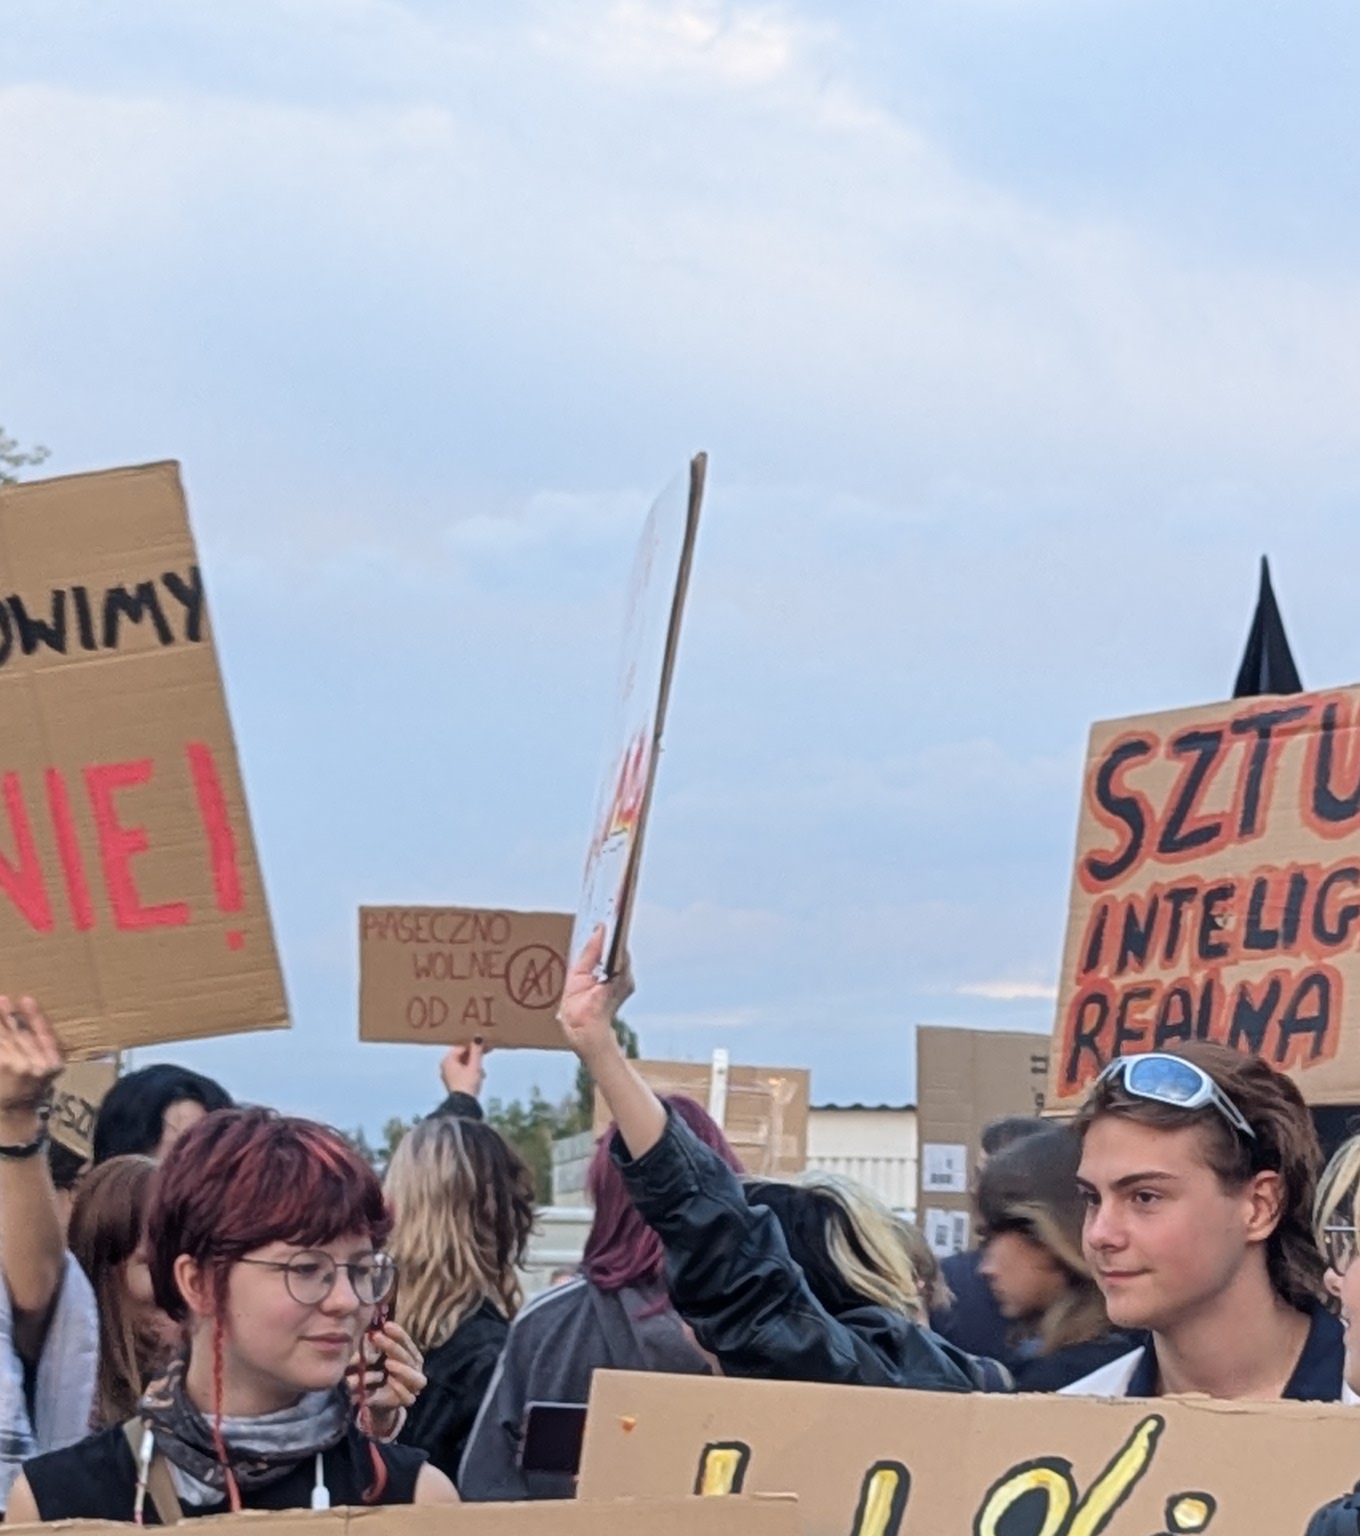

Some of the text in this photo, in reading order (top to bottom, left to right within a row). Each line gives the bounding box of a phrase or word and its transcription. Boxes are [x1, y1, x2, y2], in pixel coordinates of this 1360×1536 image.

[412, 950, 506, 981] WOLNE
[406, 996, 498, 1029] OD AI
